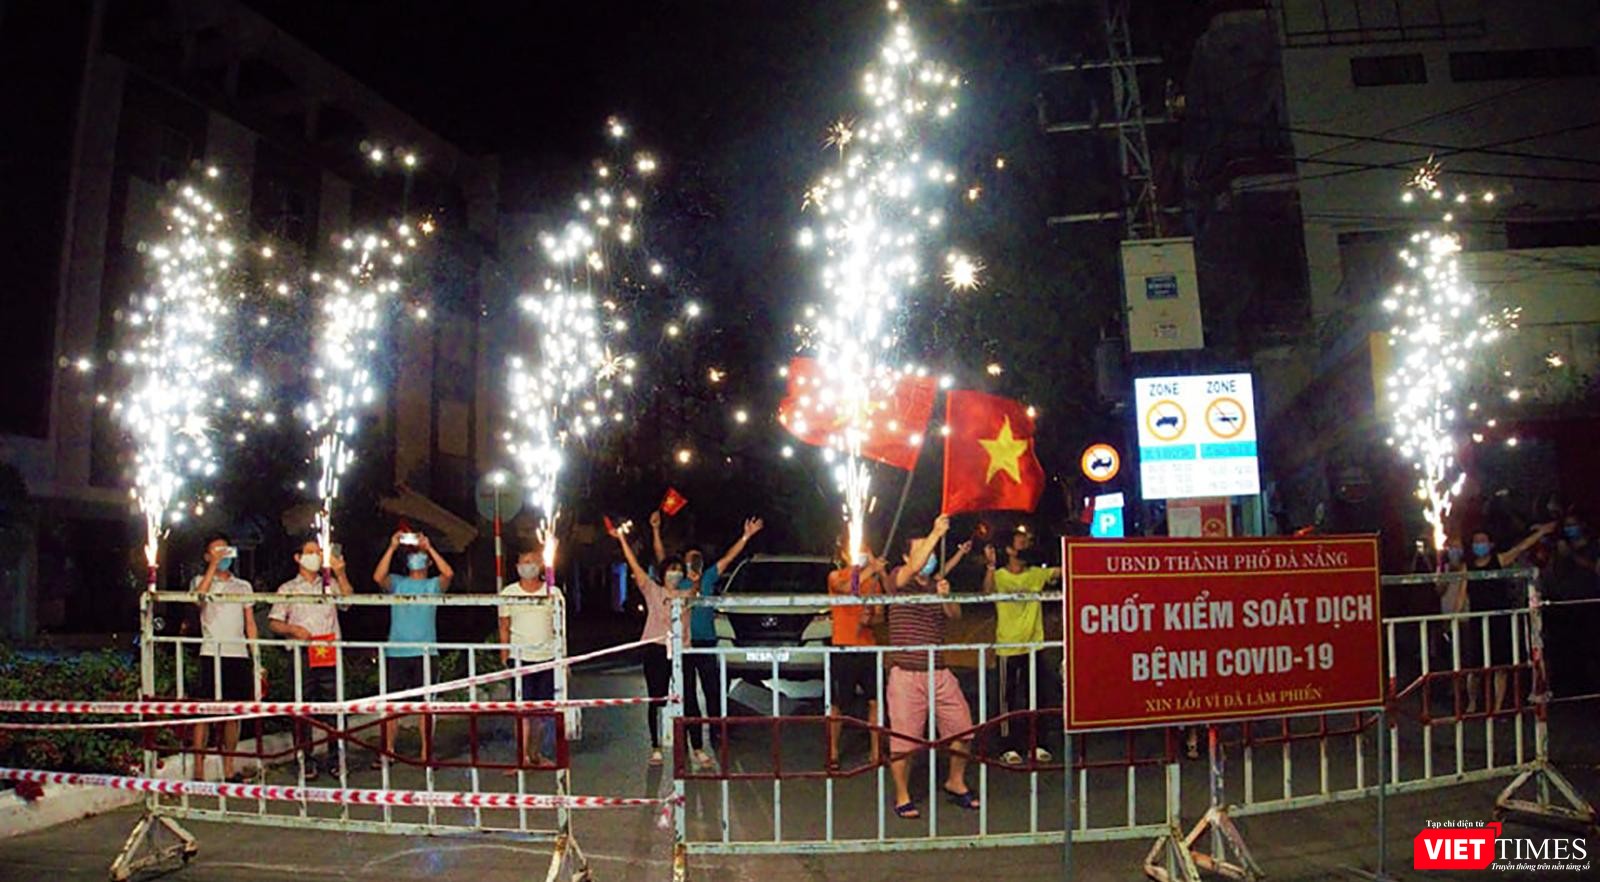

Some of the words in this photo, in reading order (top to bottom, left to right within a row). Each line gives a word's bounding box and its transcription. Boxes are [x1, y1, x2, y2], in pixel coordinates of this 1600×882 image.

[1150, 383, 1180, 396] ZONE
[1206, 380, 1237, 394] ZONE
[1100, 513, 1116, 535] P
[1106, 556, 1160, 572] UBND
[1164, 551, 1229, 571] THÀNH
[1234, 547, 1271, 570] PHỐ
[1080, 593, 1155, 634] CHỐT
[1163, 590, 1235, 630] KIỂM
[1242, 593, 1309, 628] SOÁT
[1316, 594, 1373, 628] DỊCH
[1132, 646, 1207, 686] BỆNH
[1216, 642, 1335, 676] COVID-19
[1146, 698, 1173, 712] XIN
